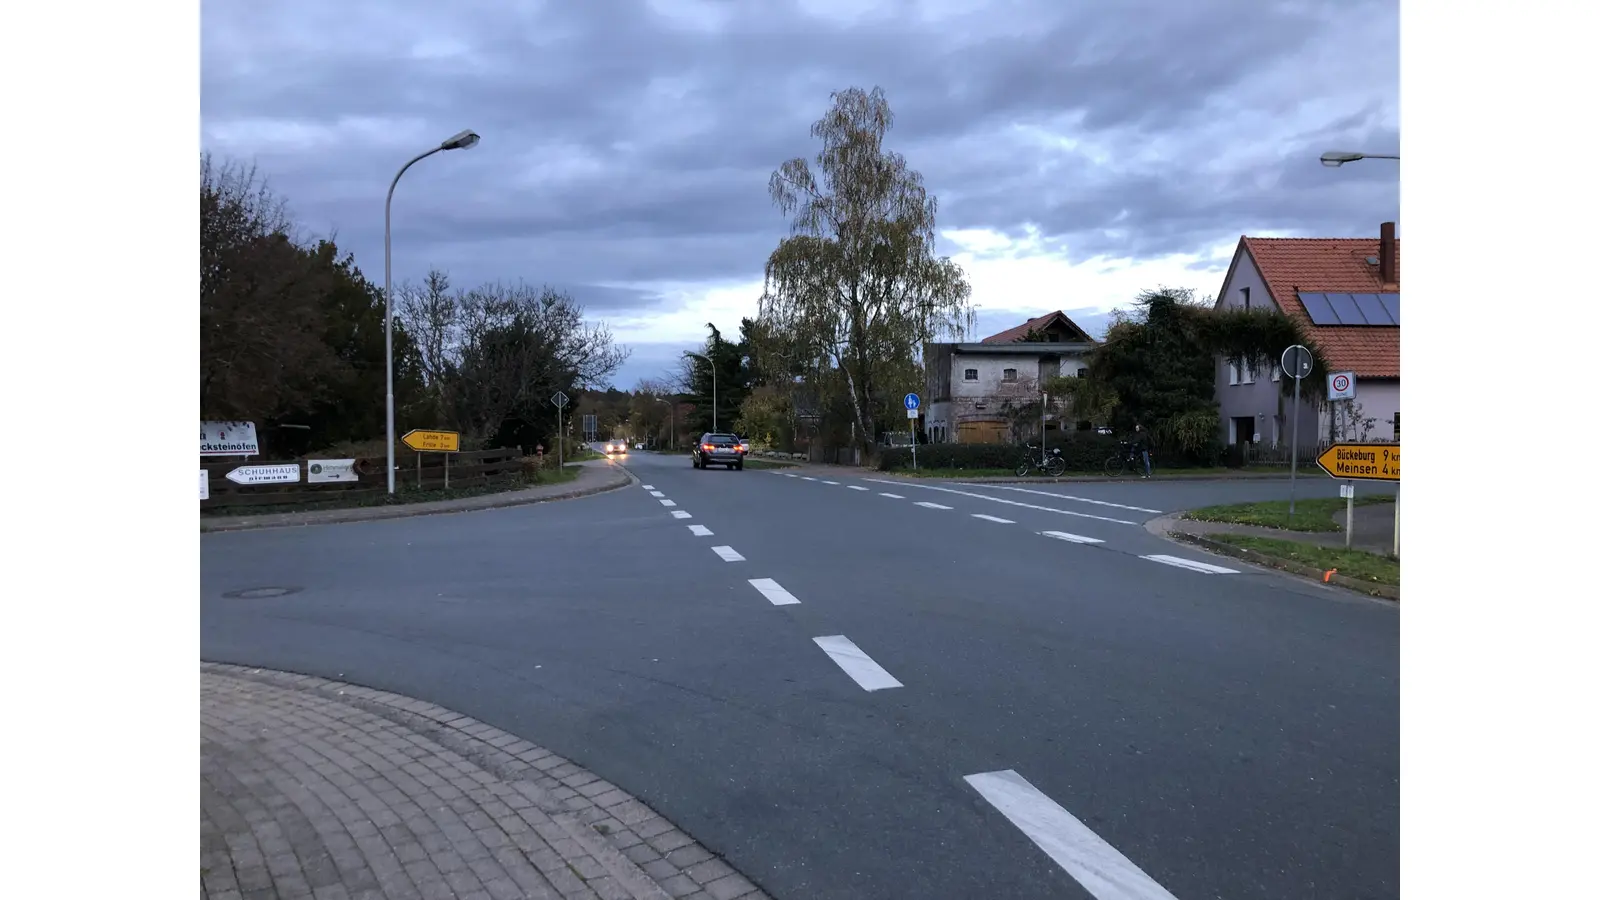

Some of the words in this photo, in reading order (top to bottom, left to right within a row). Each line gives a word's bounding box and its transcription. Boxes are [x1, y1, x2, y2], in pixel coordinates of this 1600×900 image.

[1336, 379, 1347, 388] 30
[1336, 448, 1376, 464] Bückeburg
[1383, 449, 1389, 461] 9
[238, 467, 297, 476] SCHUHHAUS
[1336, 462, 1378, 475] Meinsen
[1382, 463, 1389, 475] 4
